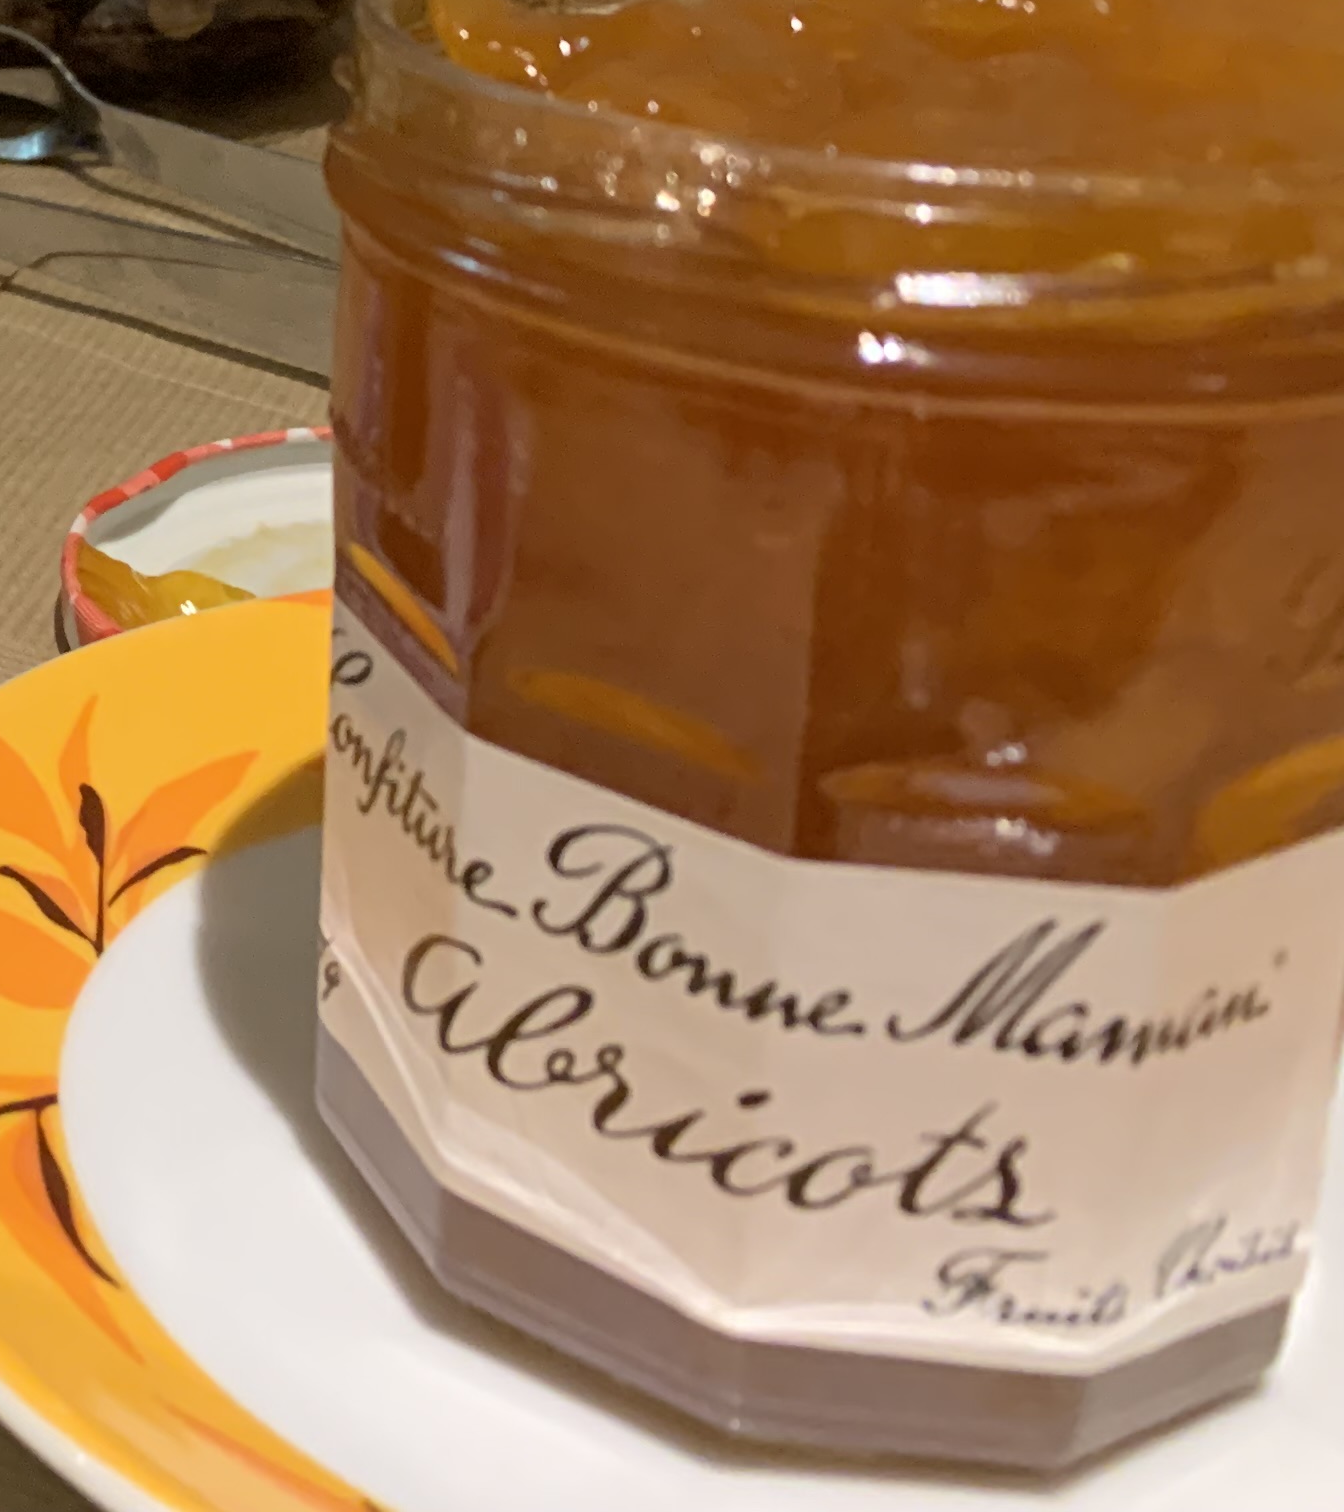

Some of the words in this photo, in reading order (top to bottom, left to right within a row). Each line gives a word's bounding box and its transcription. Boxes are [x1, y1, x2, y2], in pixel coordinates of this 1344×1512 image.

[530, 824, 867, 1037] Bonne
[401, 934, 1054, 1229] Abricots
[921, 1247, 1129, 1326] Fruits
